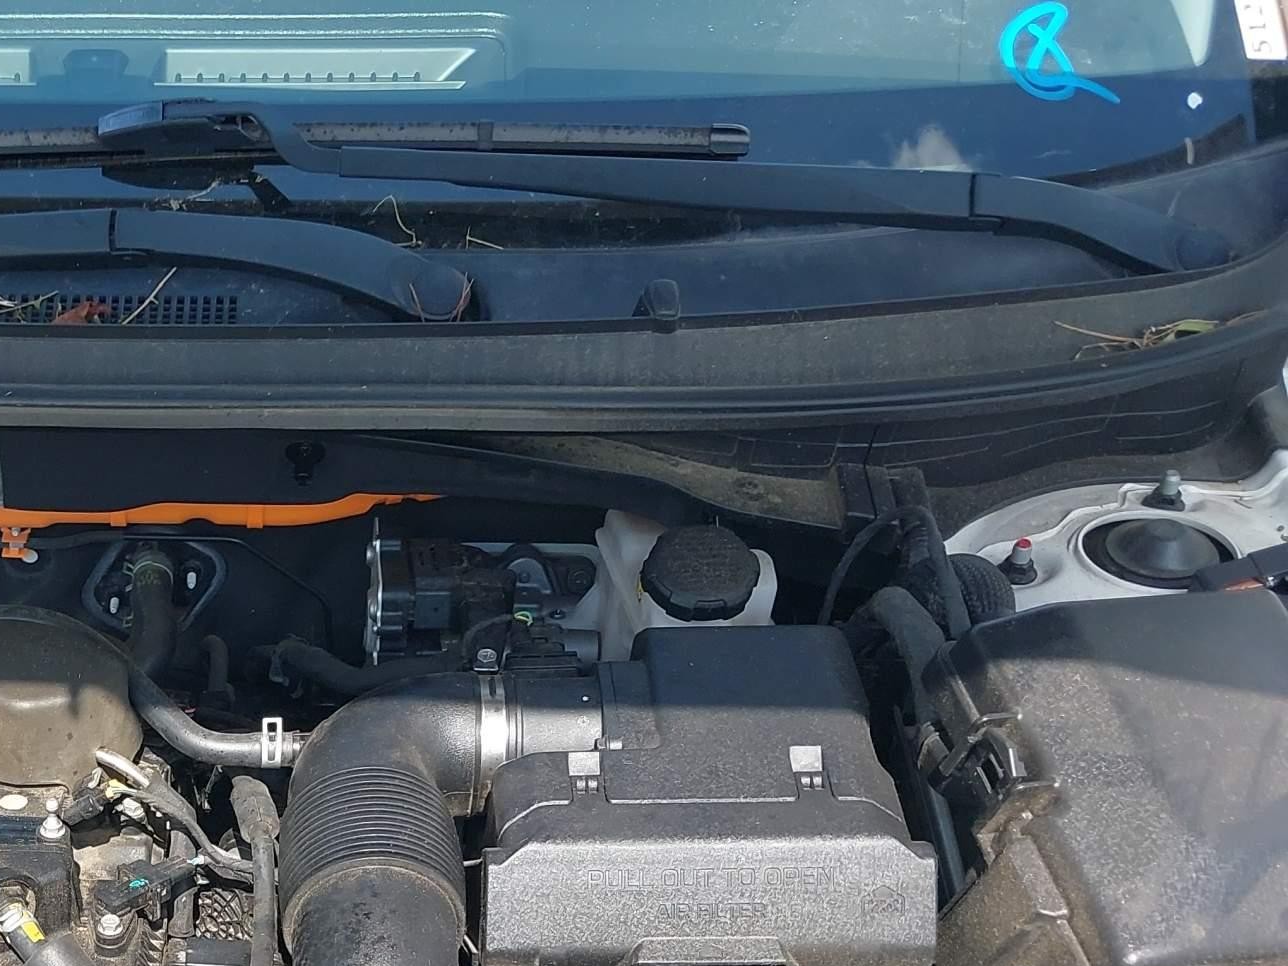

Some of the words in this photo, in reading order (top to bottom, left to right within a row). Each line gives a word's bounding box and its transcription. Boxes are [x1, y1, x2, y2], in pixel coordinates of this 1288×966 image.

[587, 869, 655, 888] PULL
[662, 868, 714, 888] OUT
[720, 867, 756, 887] TO
[764, 866, 836, 888] OPEN
